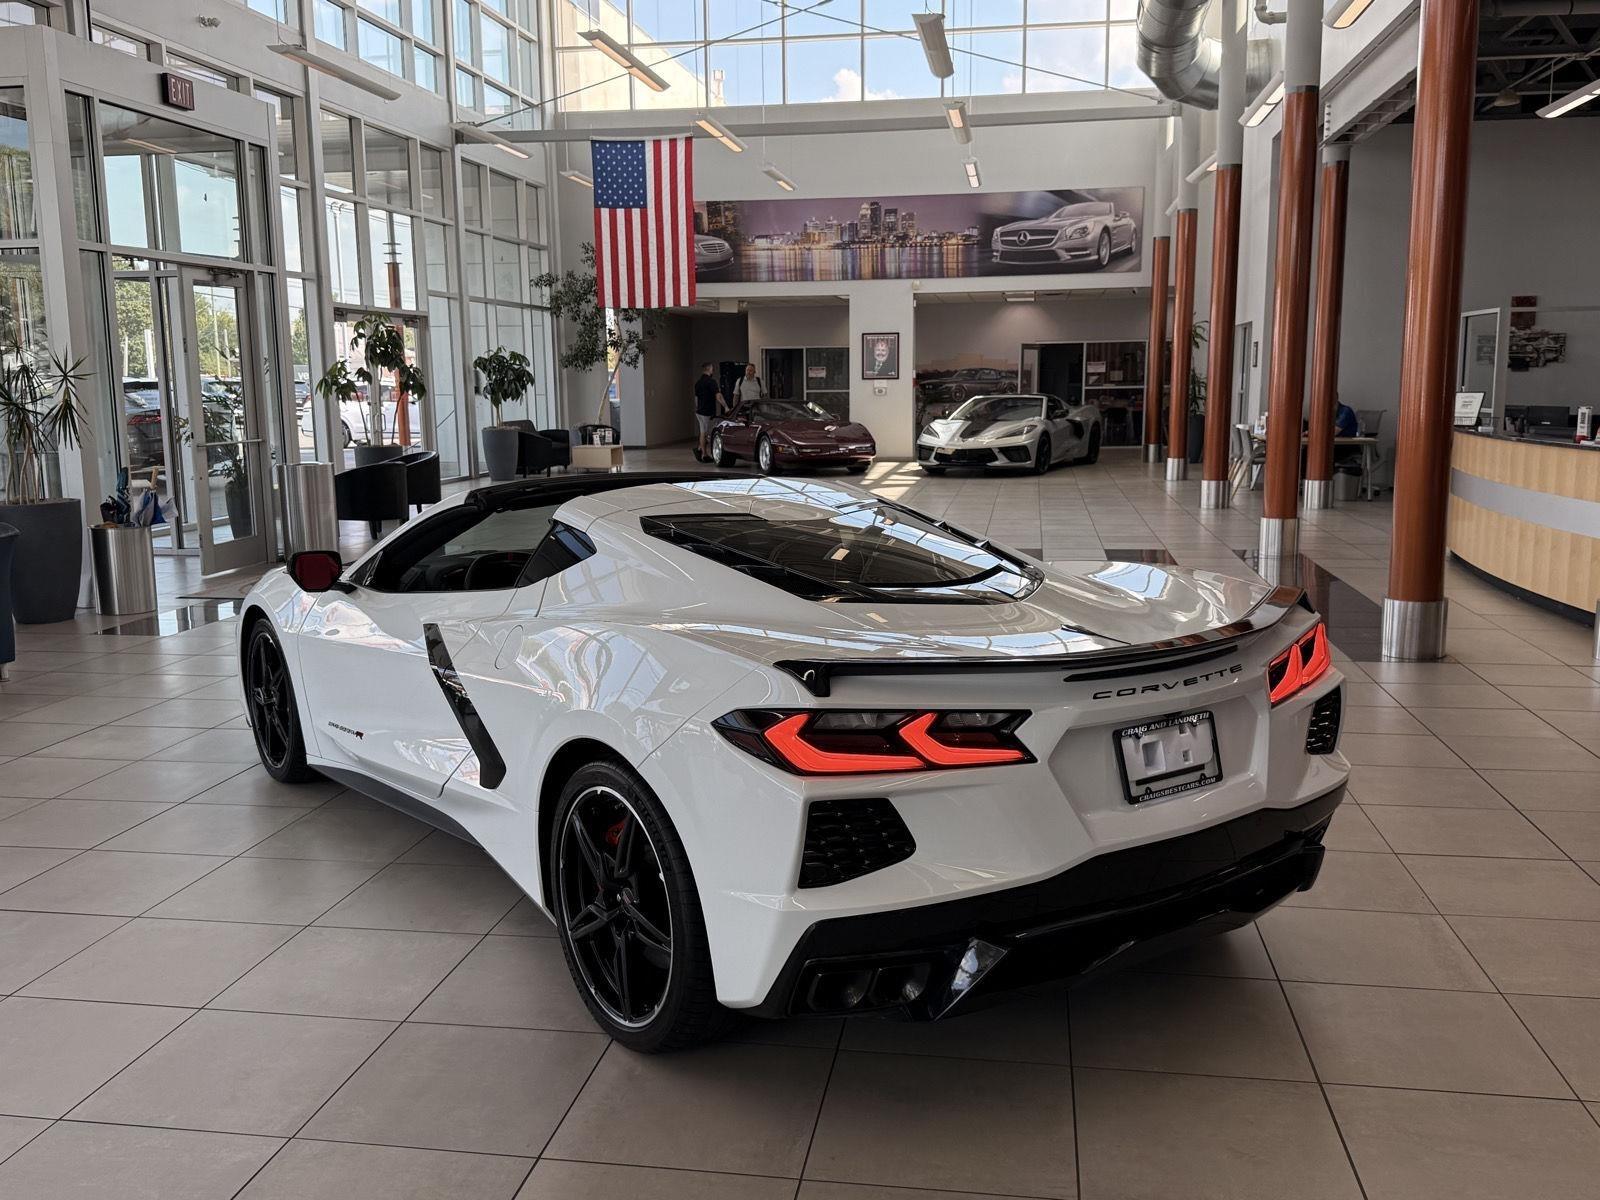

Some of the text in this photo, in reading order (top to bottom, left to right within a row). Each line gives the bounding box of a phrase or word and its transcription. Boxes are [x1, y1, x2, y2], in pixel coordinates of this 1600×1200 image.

[170, 78, 191, 106] EXIT
[1092, 663, 1243, 700] CORVETTE
[1121, 711, 1210, 737] CRAIG AND LANDRETH
[1139, 776, 1216, 802] CRAIGSBESTCARS.COM
